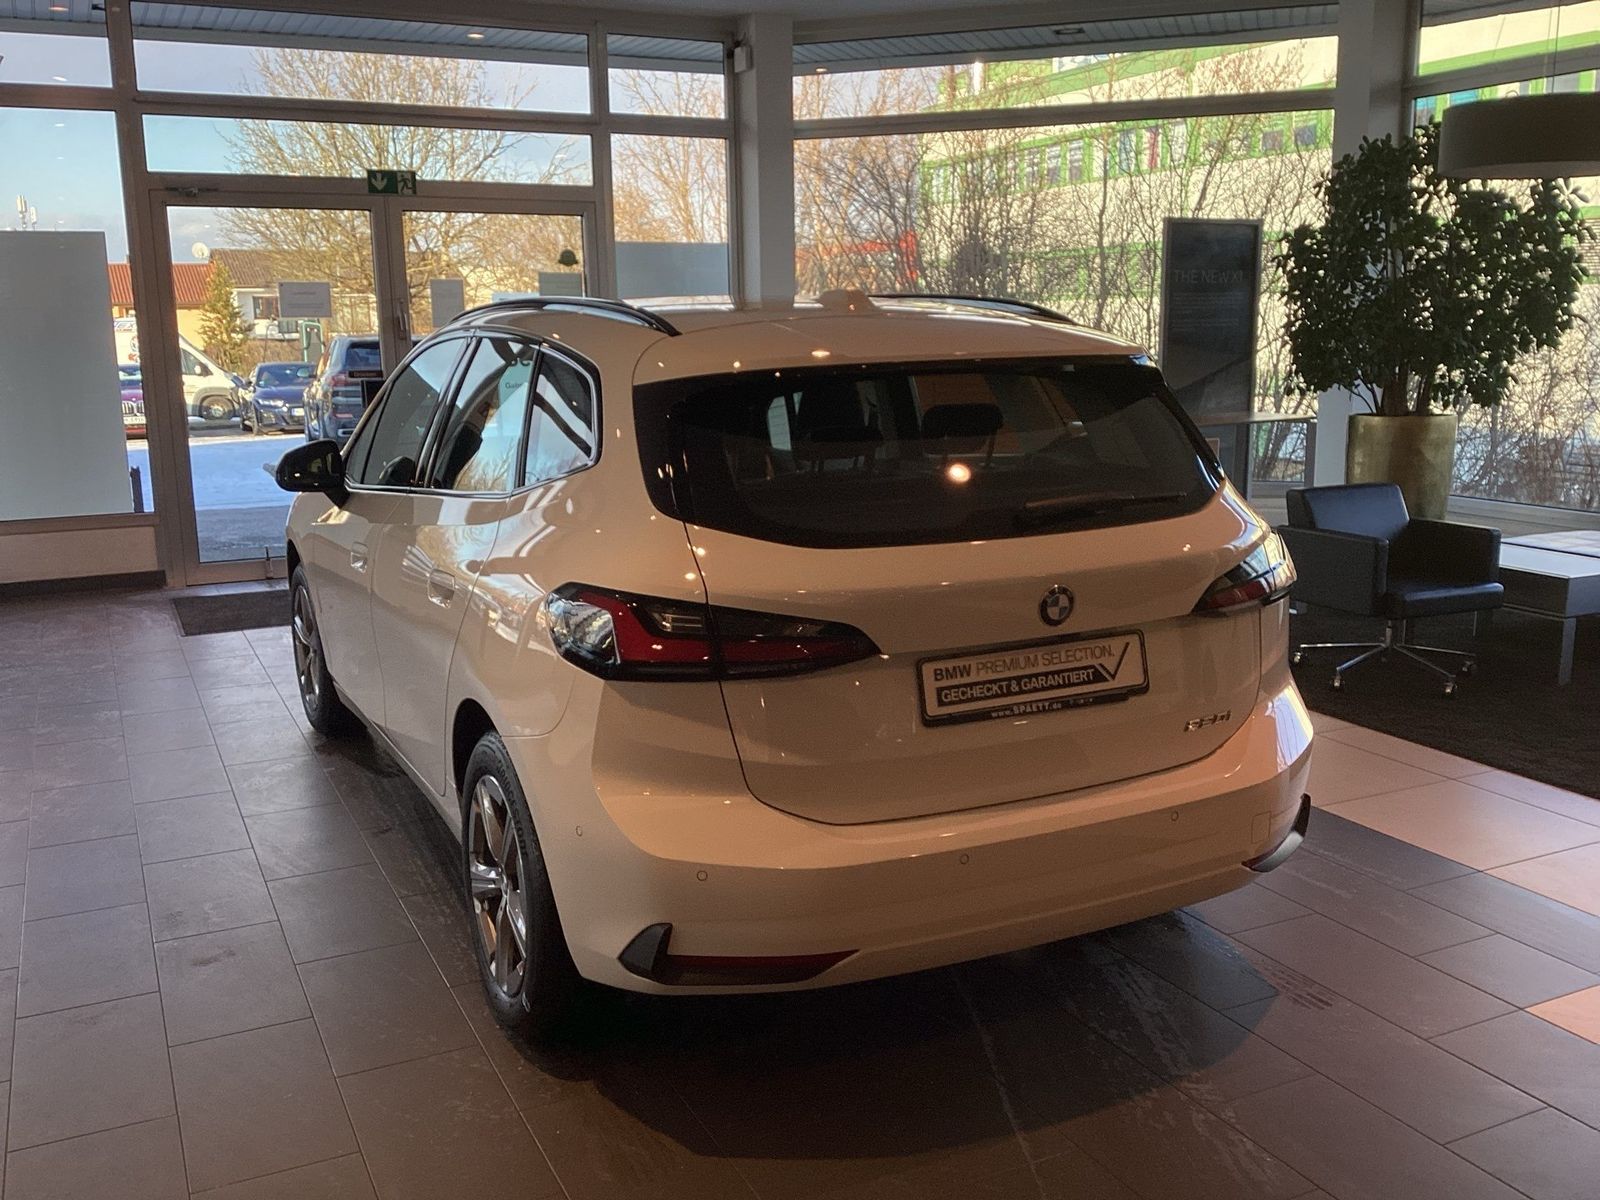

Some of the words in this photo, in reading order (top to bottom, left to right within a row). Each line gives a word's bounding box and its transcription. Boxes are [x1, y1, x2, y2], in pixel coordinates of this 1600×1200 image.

[1174, 270, 1198, 284] THE
[1201, 270, 1229, 284] NEW
[933, 664, 972, 682] BMW
[976, 655, 1040, 676] PREMIUM
[941, 681, 1009, 703] GECHECKT
[1010, 680, 1019, 692] &
[1020, 668, 1095, 690] GARANTIERT
